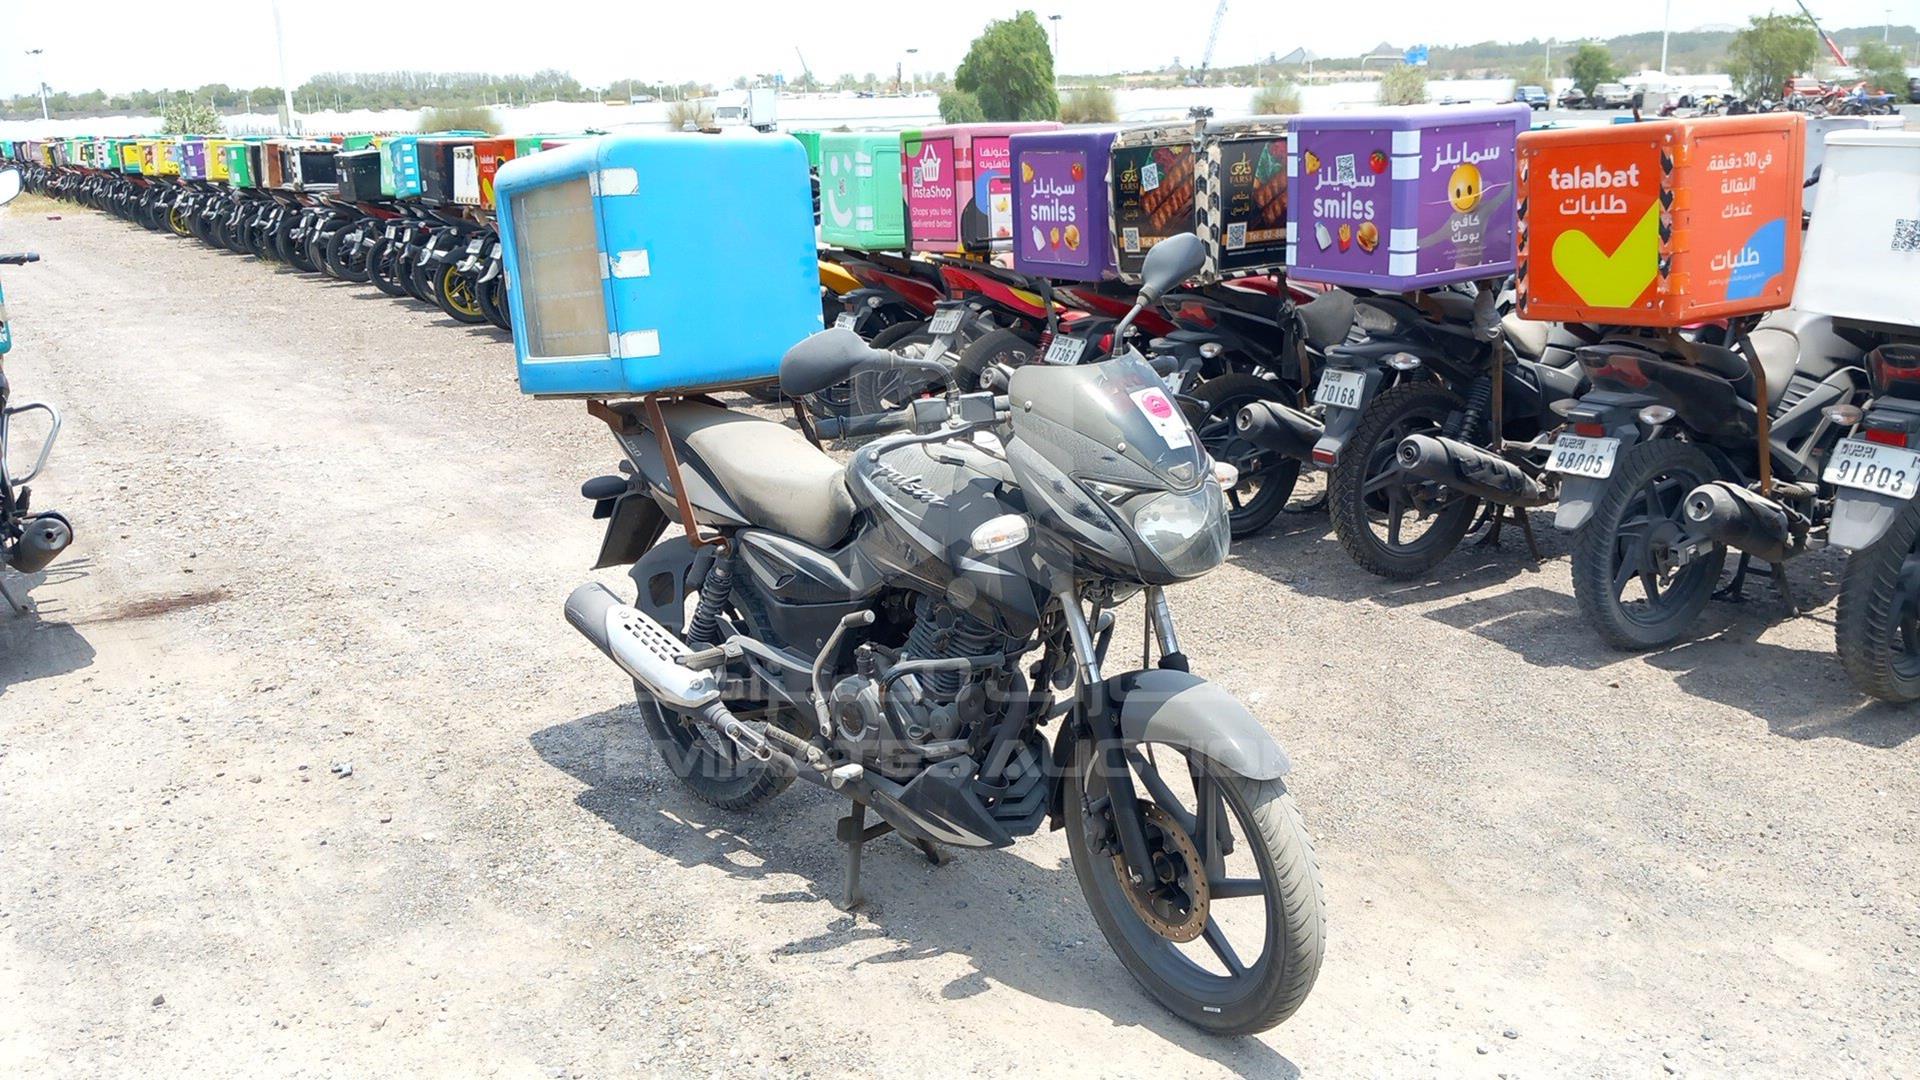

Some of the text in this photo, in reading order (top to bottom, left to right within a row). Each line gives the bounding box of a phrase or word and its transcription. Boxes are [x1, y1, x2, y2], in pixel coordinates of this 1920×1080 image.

[1431, 141, 1500, 172] سمايلز
[1743, 154, 1757, 168] 30
[1757, 151, 1773, 172] في
[1548, 163, 1640, 190] talabat
[1720, 179, 1756, 194] البقالة
[911, 185, 952, 200] InstaShop
[1031, 177, 1075, 198] سمايلز
[911, 207, 952, 217] Shops you love
[1030, 198, 1076, 222] smiles
[1313, 191, 1375, 220] smiles
[1559, 194, 1627, 221] طلبات
[1721, 203, 1753, 219] عندك
[936, 220, 952, 228] better
[1710, 246, 1760, 273] طلبات
[1050, 346, 1077, 363] 17367
[1321, 384, 1355, 405] 70168
[1555, 451, 1604, 474] 98005
[1837, 459, 1906, 492] 91803
